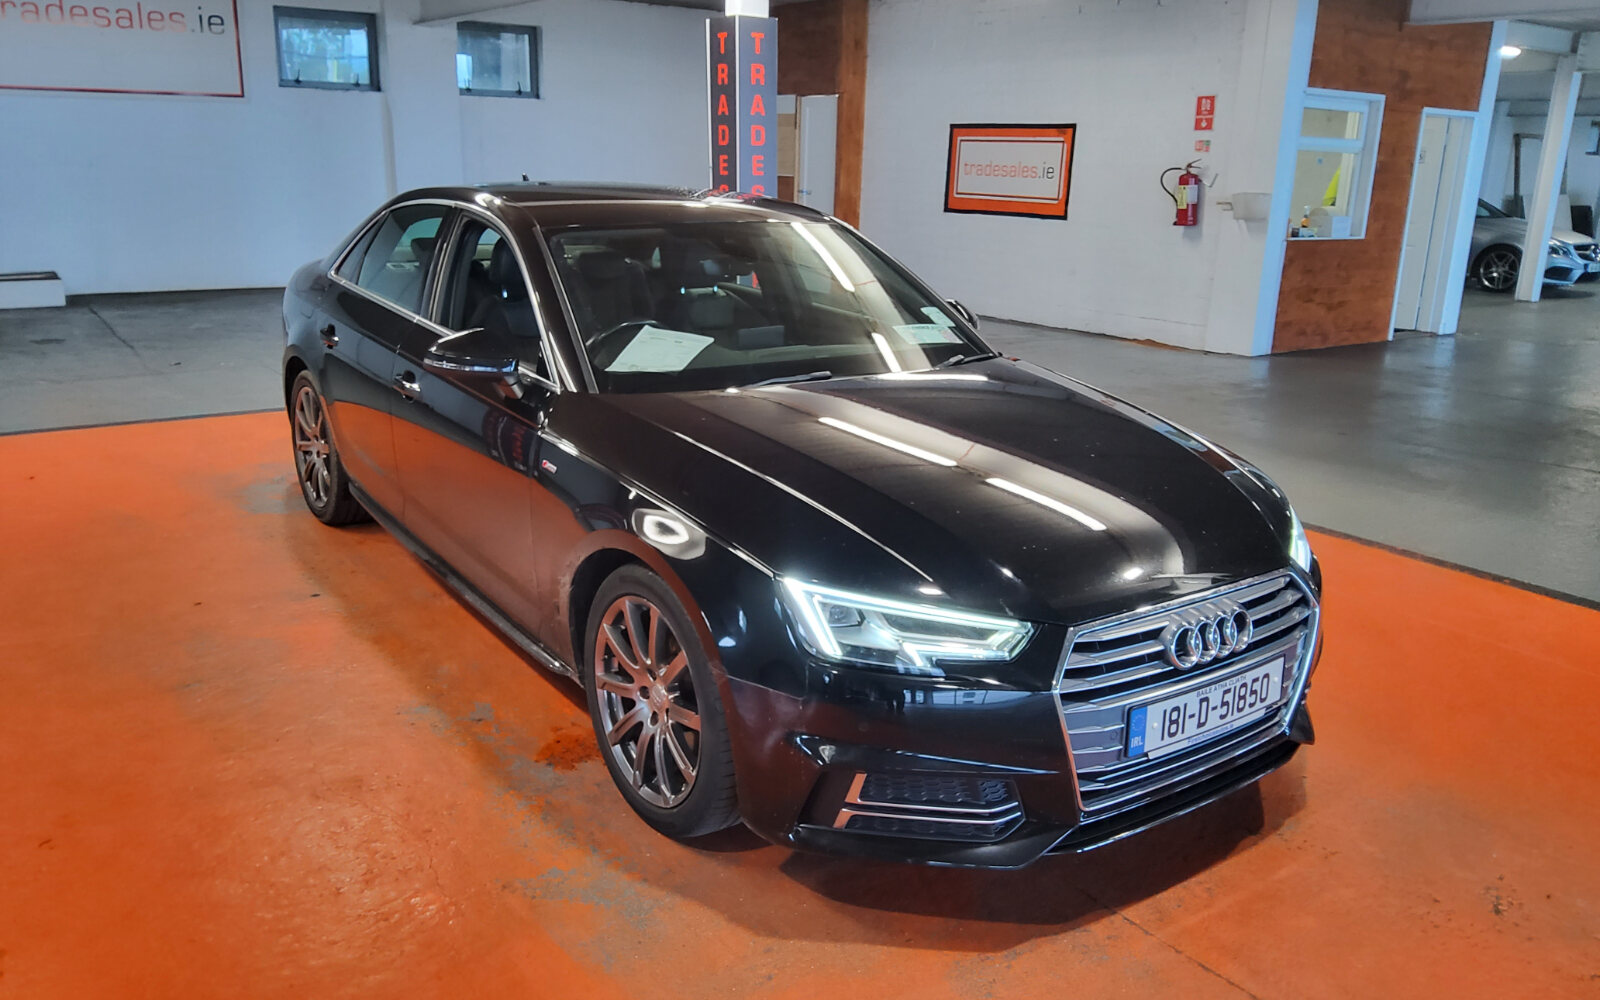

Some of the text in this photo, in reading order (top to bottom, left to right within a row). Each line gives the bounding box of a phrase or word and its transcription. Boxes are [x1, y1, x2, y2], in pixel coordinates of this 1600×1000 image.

[963, 160, 1056, 180] tradesales.ie
[1196, 687, 1212, 698] BAILE
[1161, 672, 1270, 741] 181-D-51850
[1131, 735, 1144, 748] IRL
